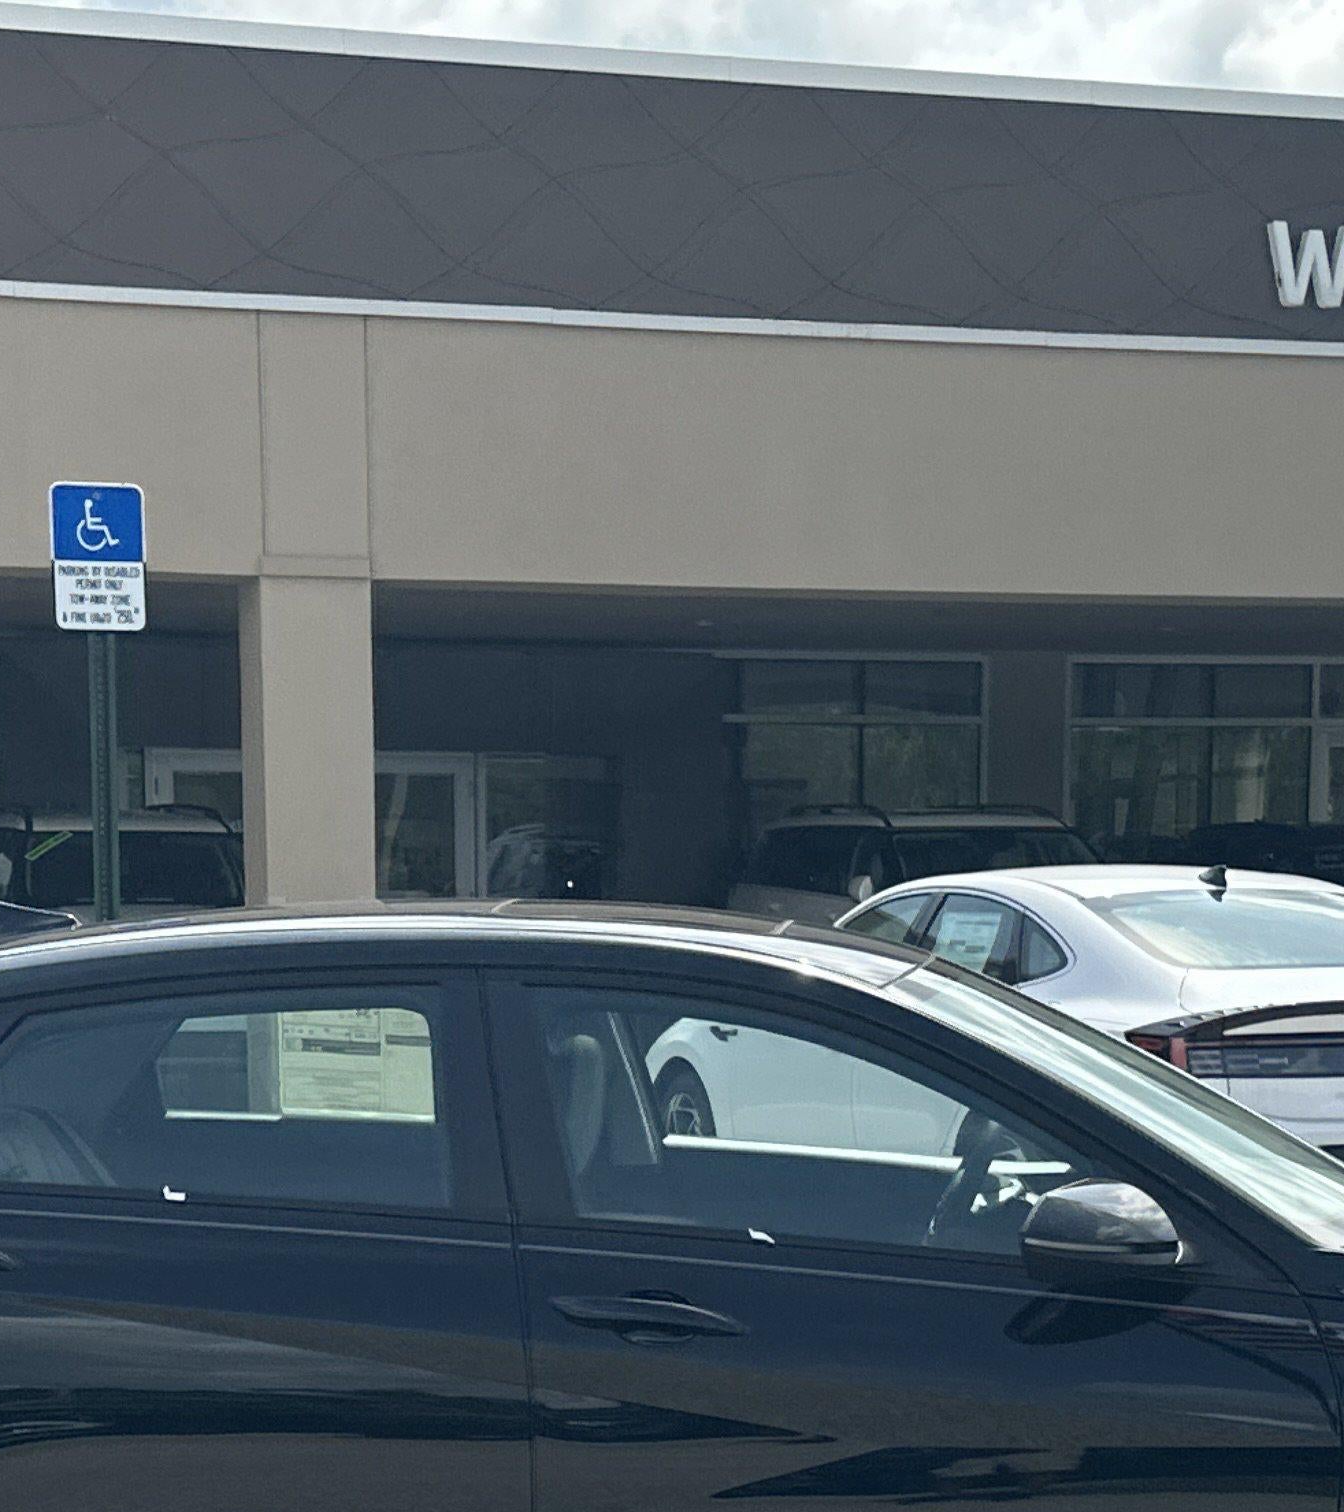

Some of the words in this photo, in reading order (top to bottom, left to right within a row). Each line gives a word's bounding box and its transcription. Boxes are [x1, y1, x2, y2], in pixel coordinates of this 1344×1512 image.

[58, 565, 89, 576] PARKING
[92, 566, 102, 577] BY
[104, 566, 141, 578] DISABLED
[104, 579, 124, 591] ONLY
[111, 594, 131, 606] ZONE
[70, 612, 87, 623] FINE
